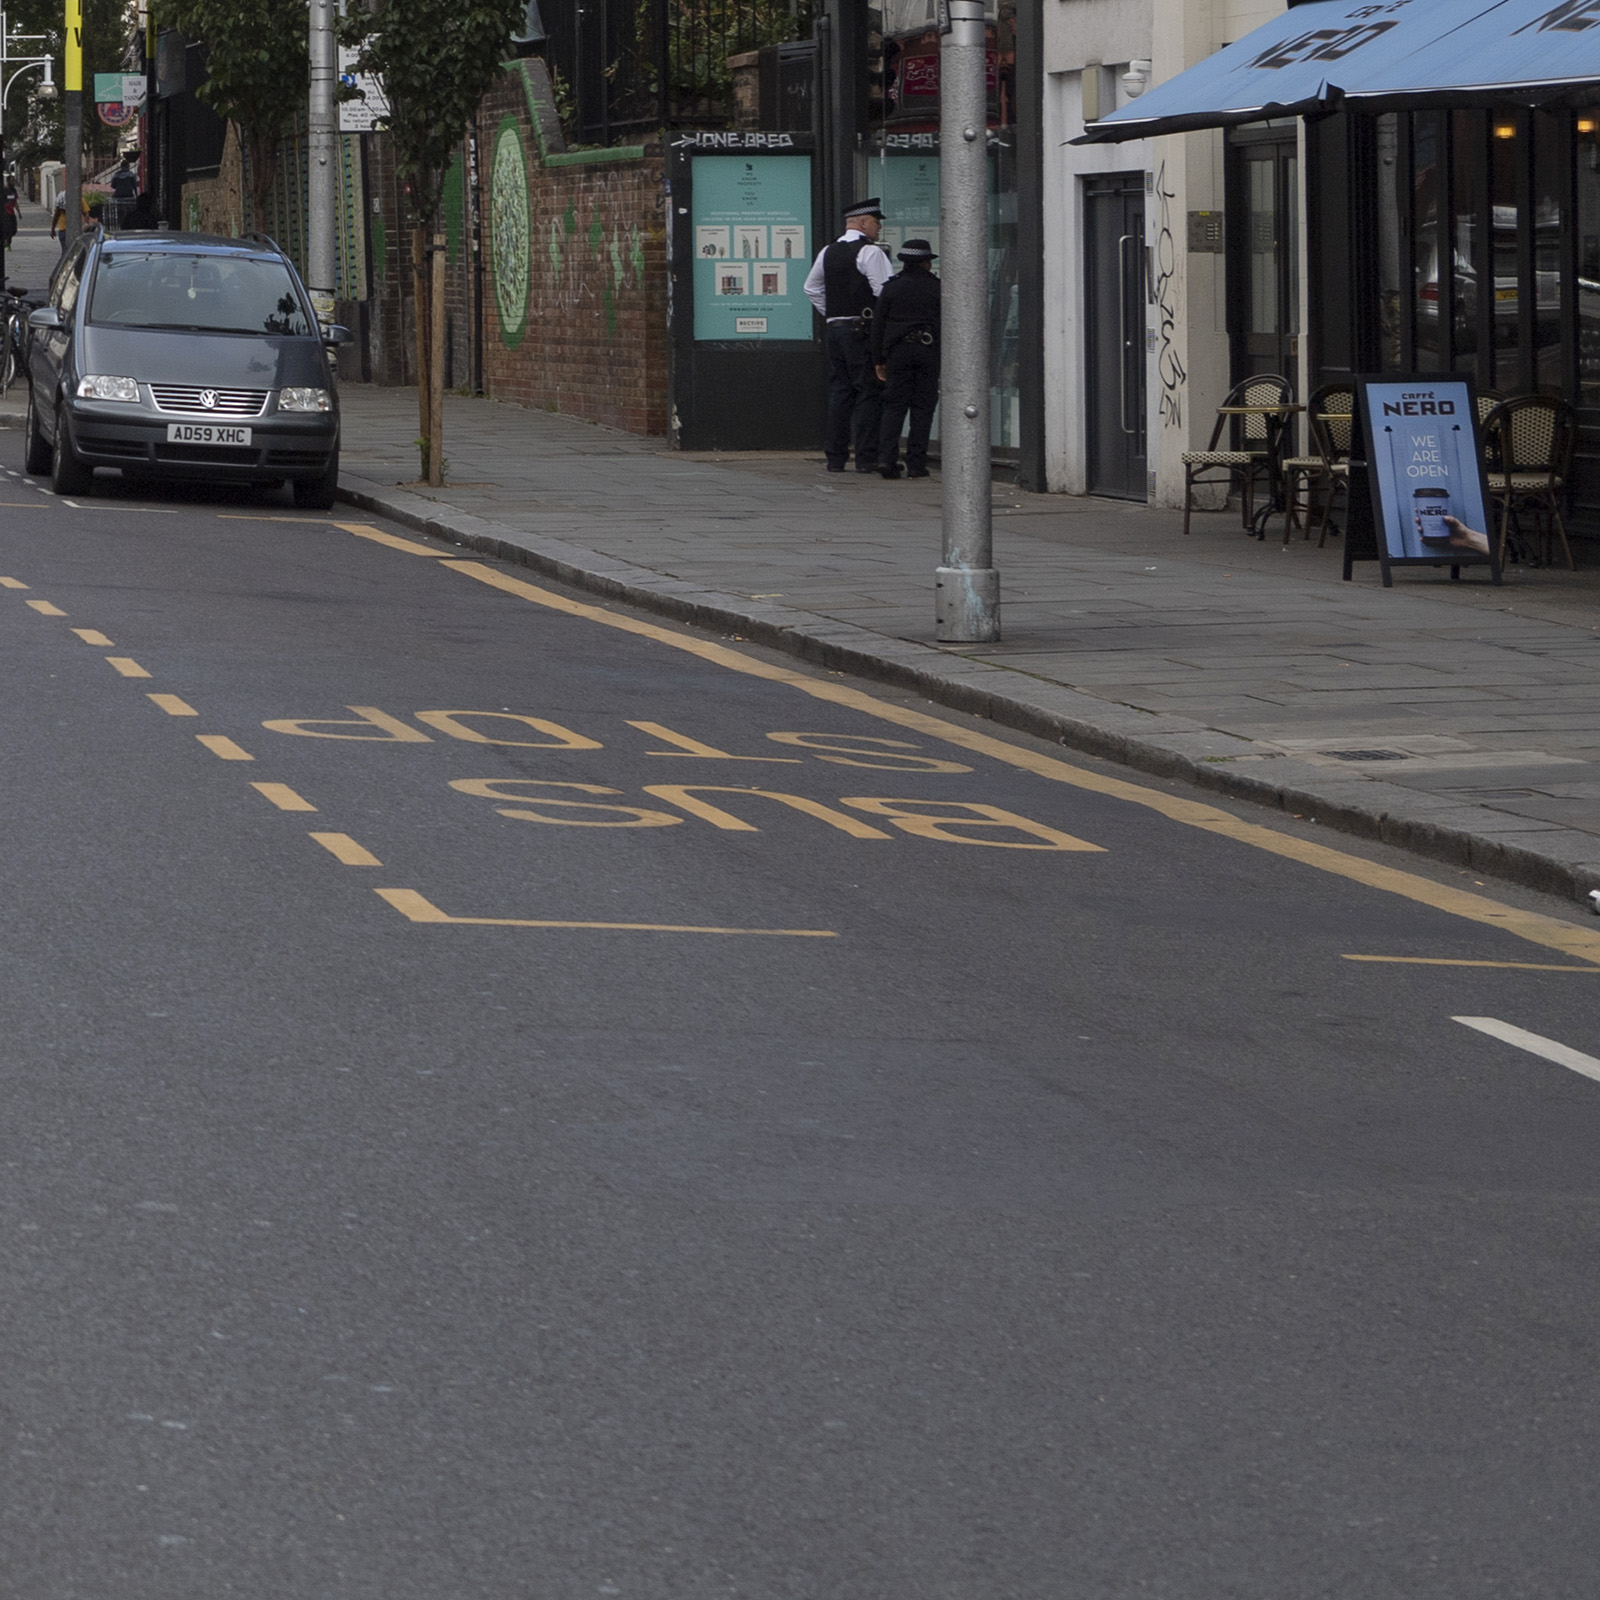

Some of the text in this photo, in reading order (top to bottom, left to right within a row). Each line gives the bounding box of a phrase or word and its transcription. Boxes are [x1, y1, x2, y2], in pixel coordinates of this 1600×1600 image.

[1401, 390, 1435, 400] CAFFÈ
[1383, 400, 1456, 416] NERO
[173, 426, 246, 443] AD59 XHC
[1411, 435, 1437, 448] WE
[1411, 450, 1441, 463] ARE
[1406, 465, 1449, 477] OPEN
